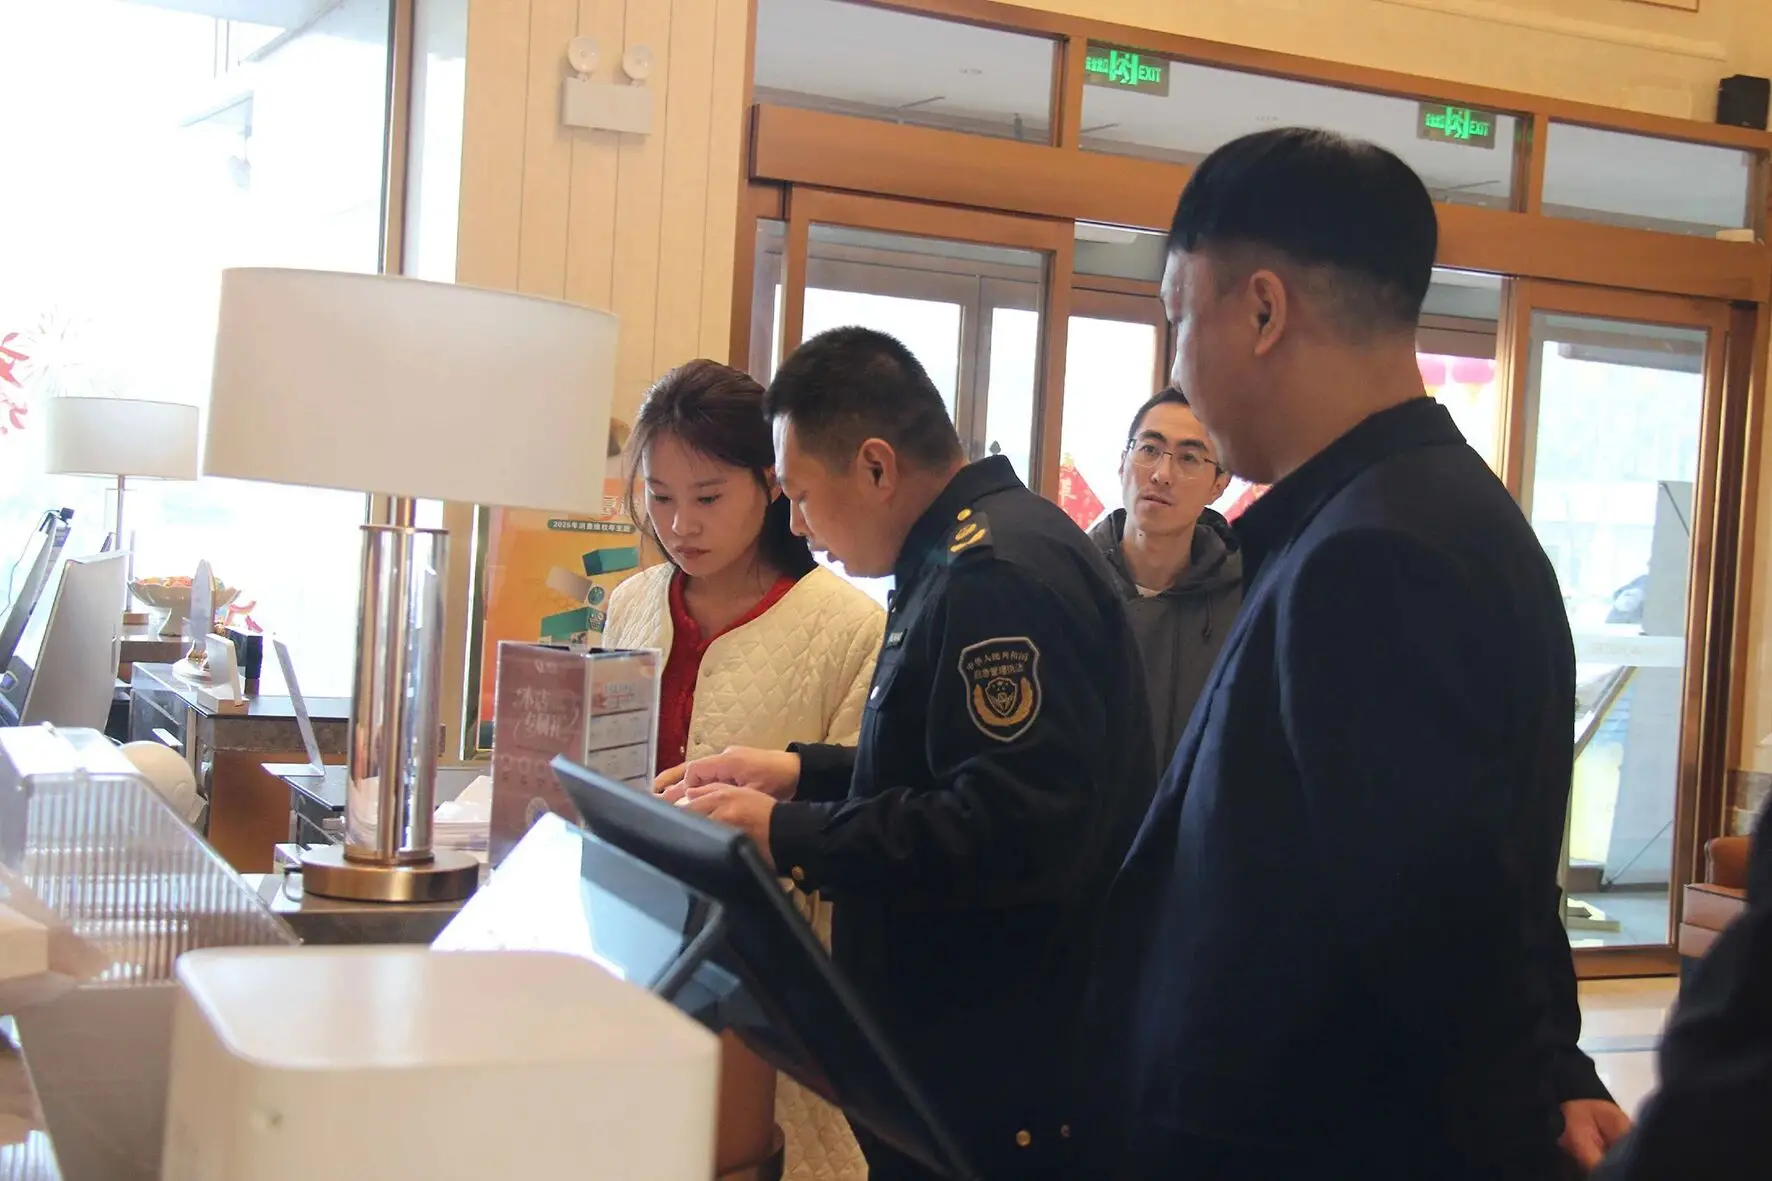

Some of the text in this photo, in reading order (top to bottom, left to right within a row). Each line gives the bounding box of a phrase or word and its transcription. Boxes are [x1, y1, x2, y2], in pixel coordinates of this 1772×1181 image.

[1138, 65, 1161, 82] EXIT
[1469, 121, 1489, 137] EXIT
[966, 650, 1028, 670] 中华人民共和国
